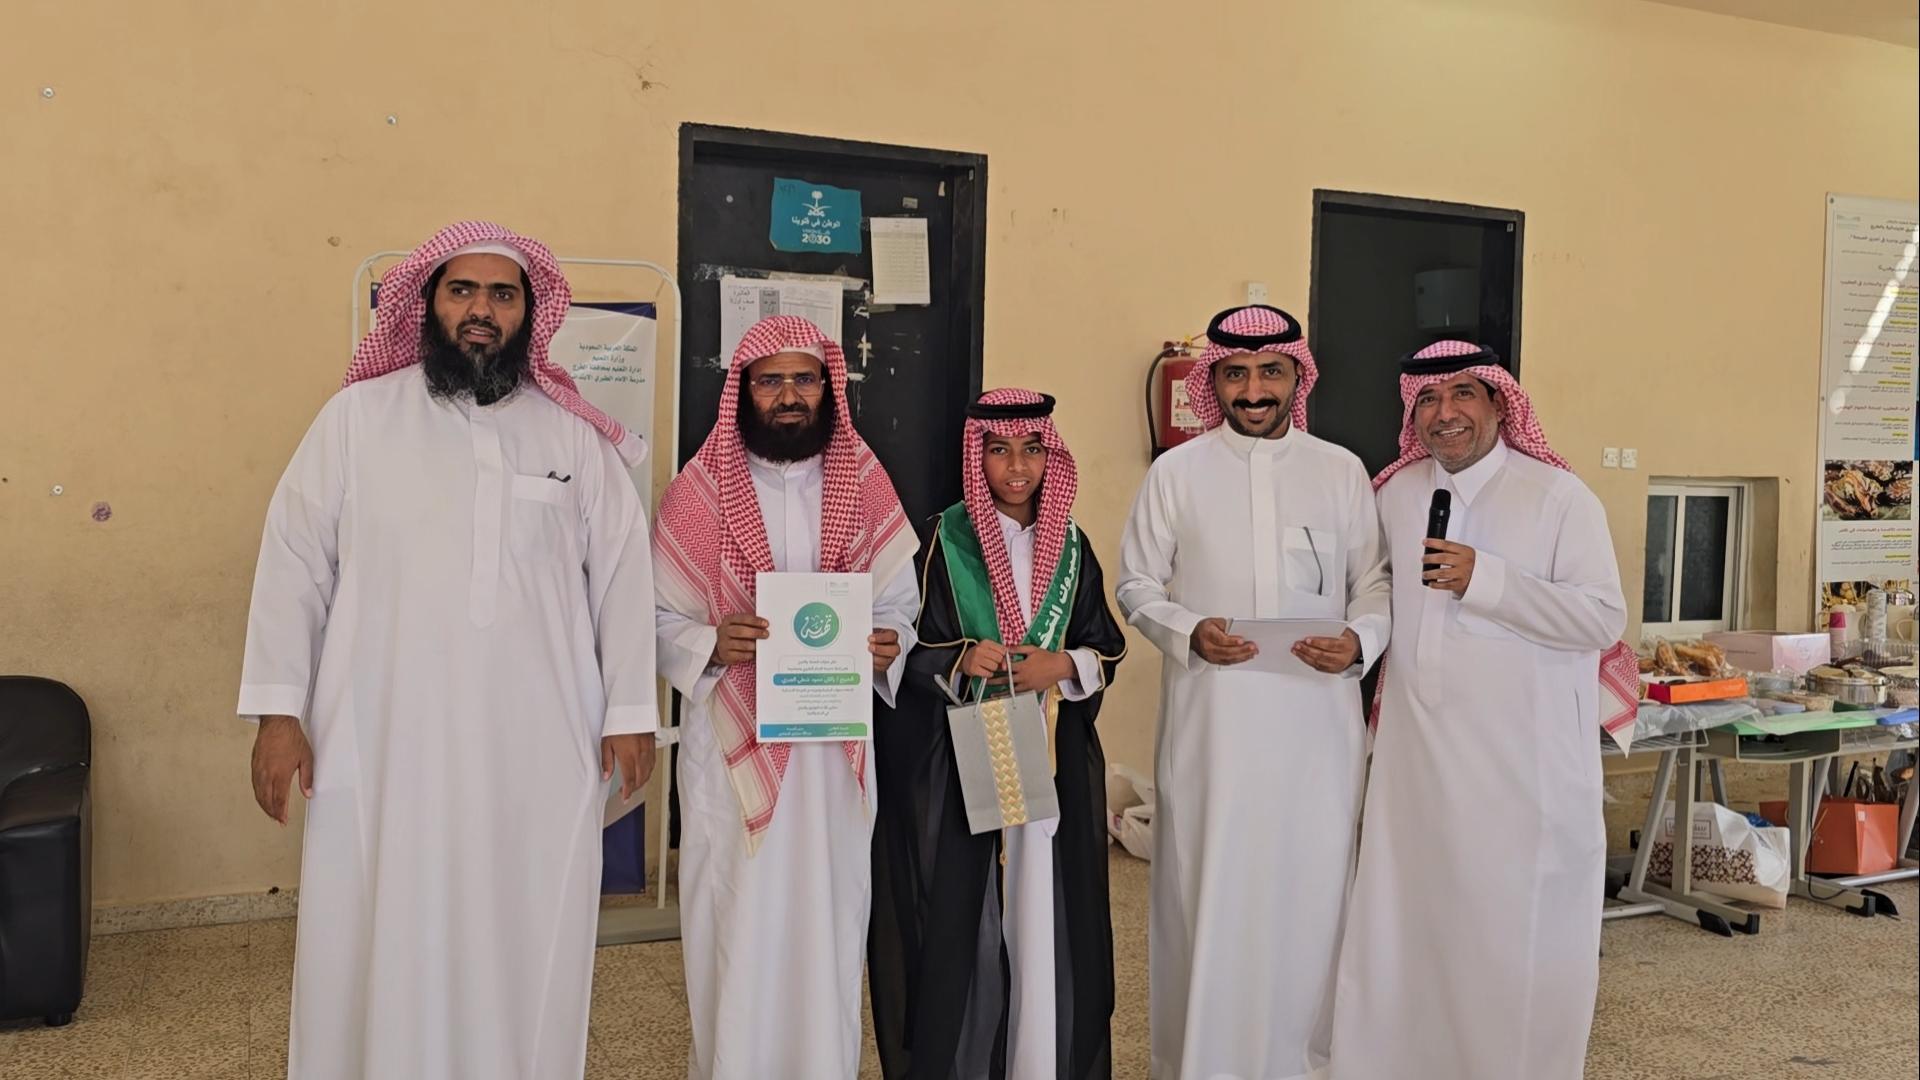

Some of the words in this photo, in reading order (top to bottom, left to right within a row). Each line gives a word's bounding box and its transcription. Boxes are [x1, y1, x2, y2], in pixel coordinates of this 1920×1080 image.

[810, 217, 821, 228] في
[801, 233, 832, 245] 2030
[579, 342, 602, 353] السعودية
[604, 343, 622, 352] العربية
[592, 354, 609, 362] التعليم
[610, 354, 625, 363] وزارة
[1059, 547, 1077, 605] مبروك
[1038, 604, 1063, 650] التخ
